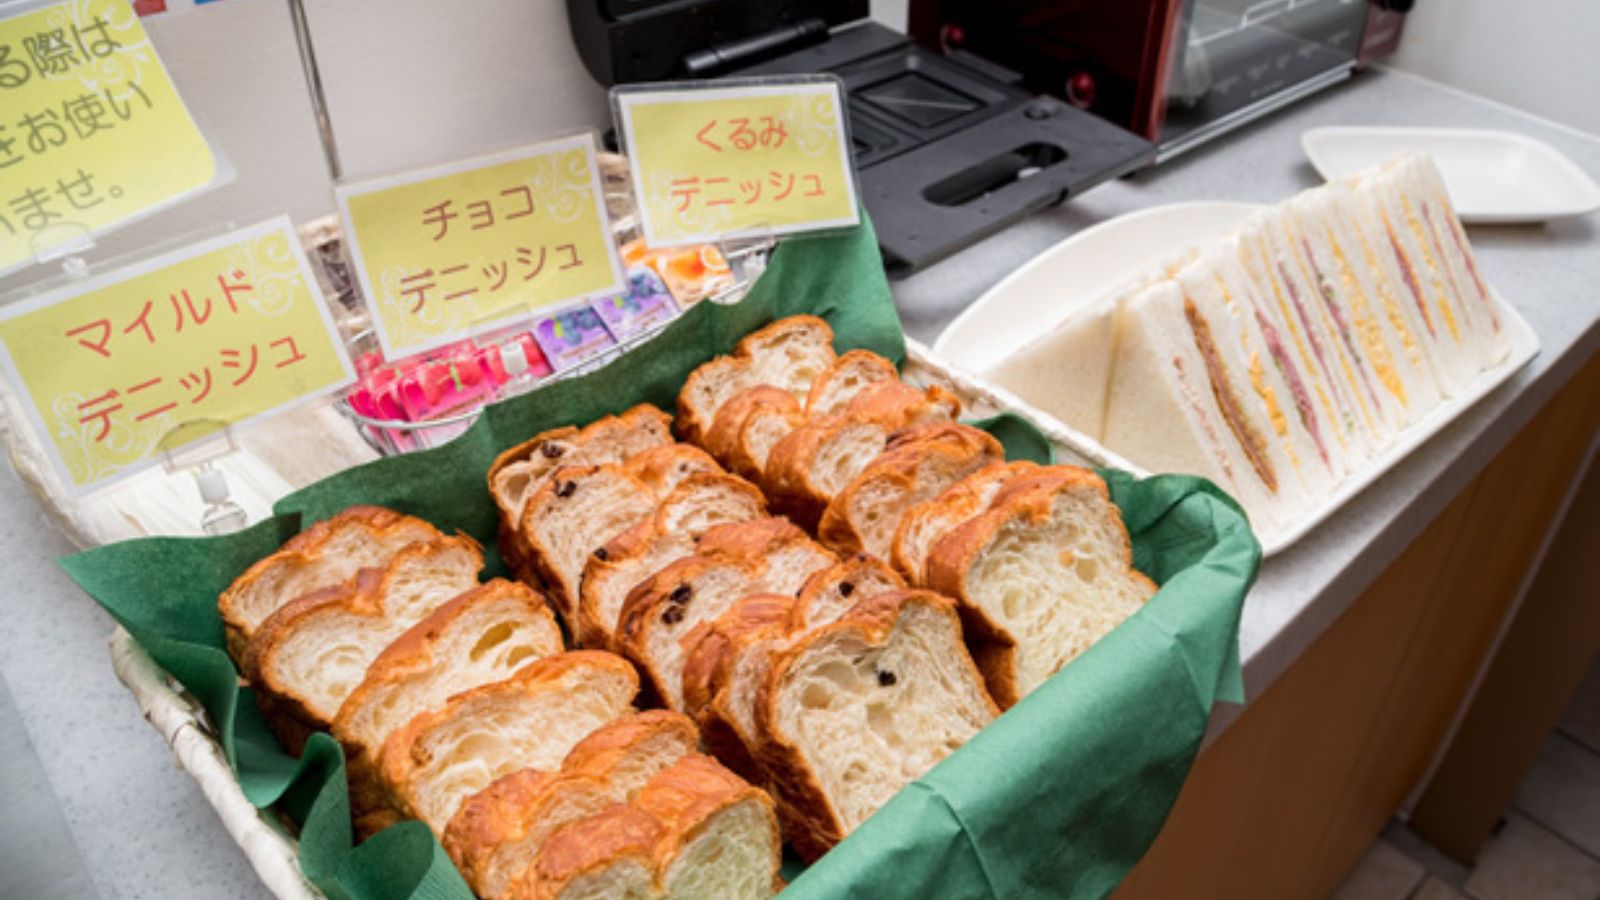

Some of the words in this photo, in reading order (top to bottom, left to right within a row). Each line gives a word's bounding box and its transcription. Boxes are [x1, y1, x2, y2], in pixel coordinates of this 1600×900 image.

[695, 116, 788, 152] くるみ
[422, 185, 534, 241] チョコ
[671, 171, 826, 211] デニッシュ
[400, 244, 583, 313] デニッシュ
[65, 269, 253, 357] マイルド
[77, 336, 306, 442] デニッシュ
